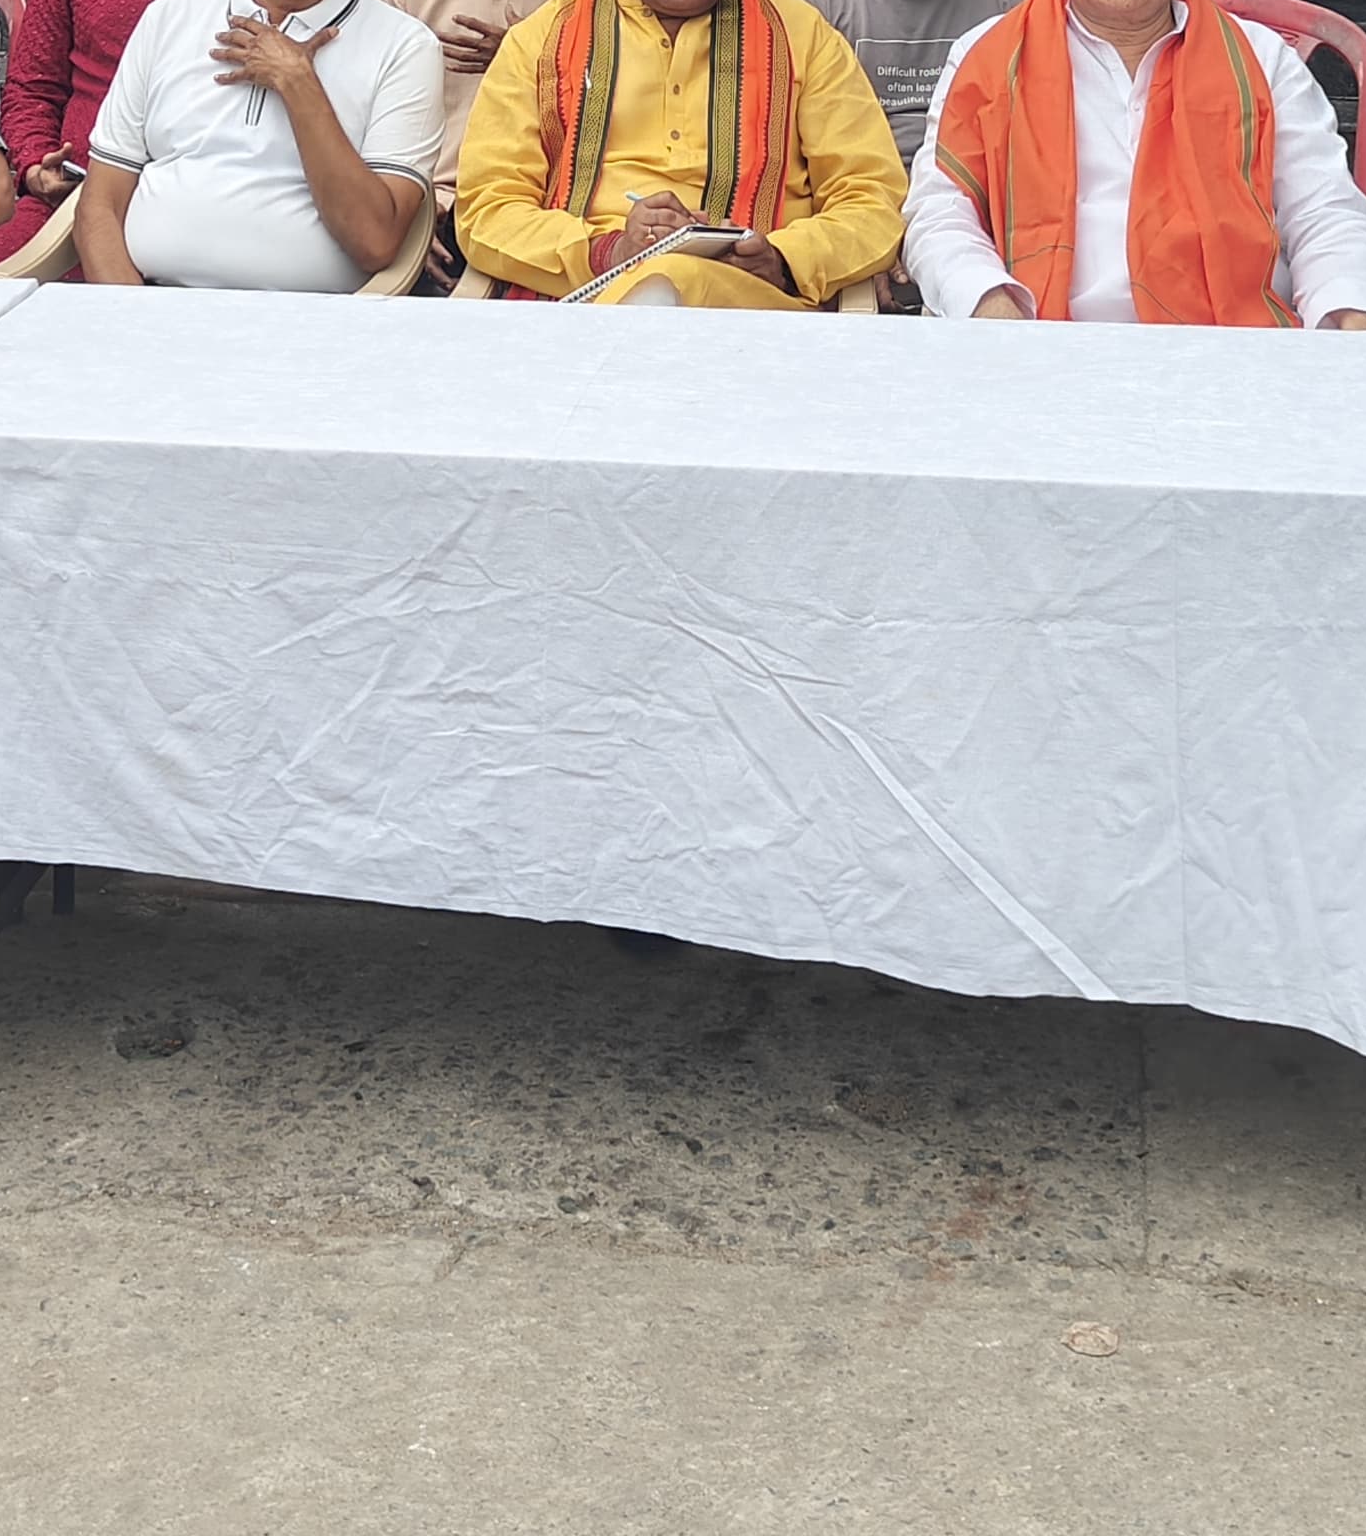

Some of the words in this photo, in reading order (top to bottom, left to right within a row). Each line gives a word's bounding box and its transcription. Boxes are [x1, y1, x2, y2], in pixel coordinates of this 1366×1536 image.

[877, 66, 917, 77] Difficult
[919, 65, 944, 77] road
[887, 82, 913, 93] often
